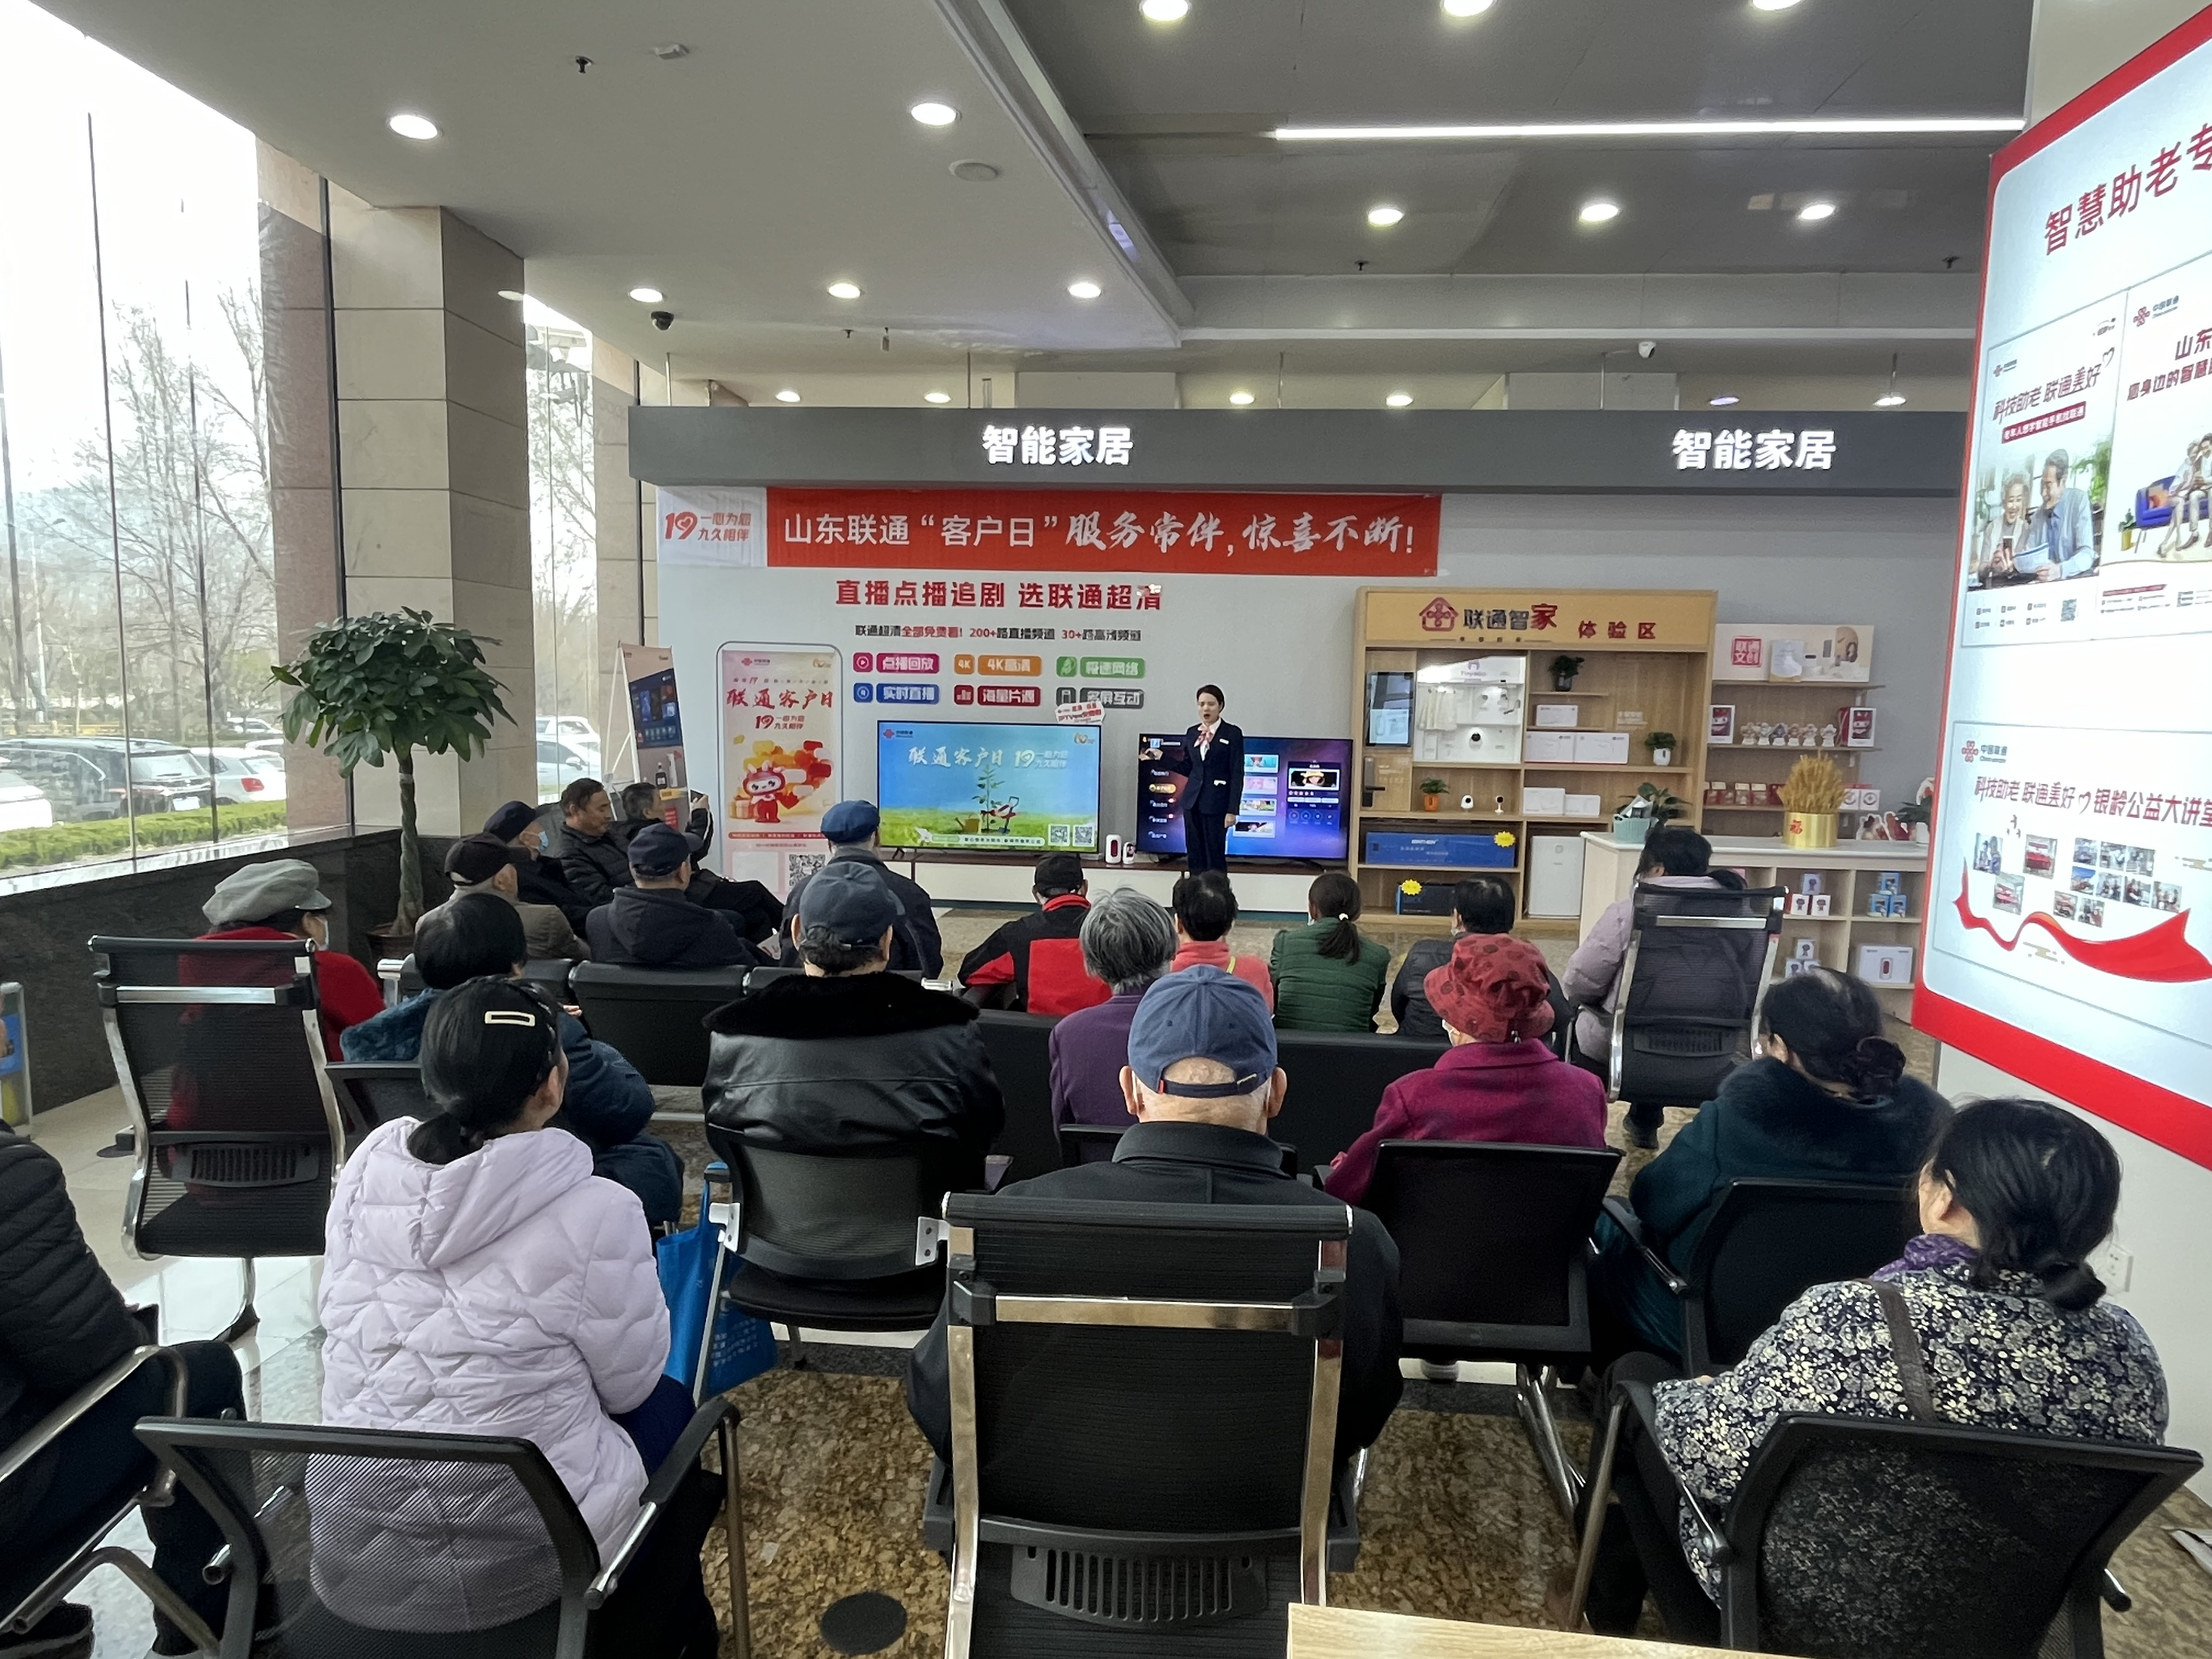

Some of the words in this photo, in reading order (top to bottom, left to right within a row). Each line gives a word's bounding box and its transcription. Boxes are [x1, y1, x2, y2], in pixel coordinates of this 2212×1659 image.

[2045, 123, 2212, 256] 智慧助老专
[983, 425, 1133, 465] 智能家居
[1672, 429, 1837, 470] 智能家居
[836, 580, 1005, 607] 直播点播追剧
[1463, 603, 1558, 630] 联通智家
[1578, 620, 1656, 639] 体验区
[882, 656, 934, 670] 点播回放
[883, 686, 935, 701] 实时直播
[909, 746, 1003, 768] 联通客户日
[2022, 781, 2076, 809] 联通美好
[2094, 788, 2212, 827] 银龄公益大讲堂
